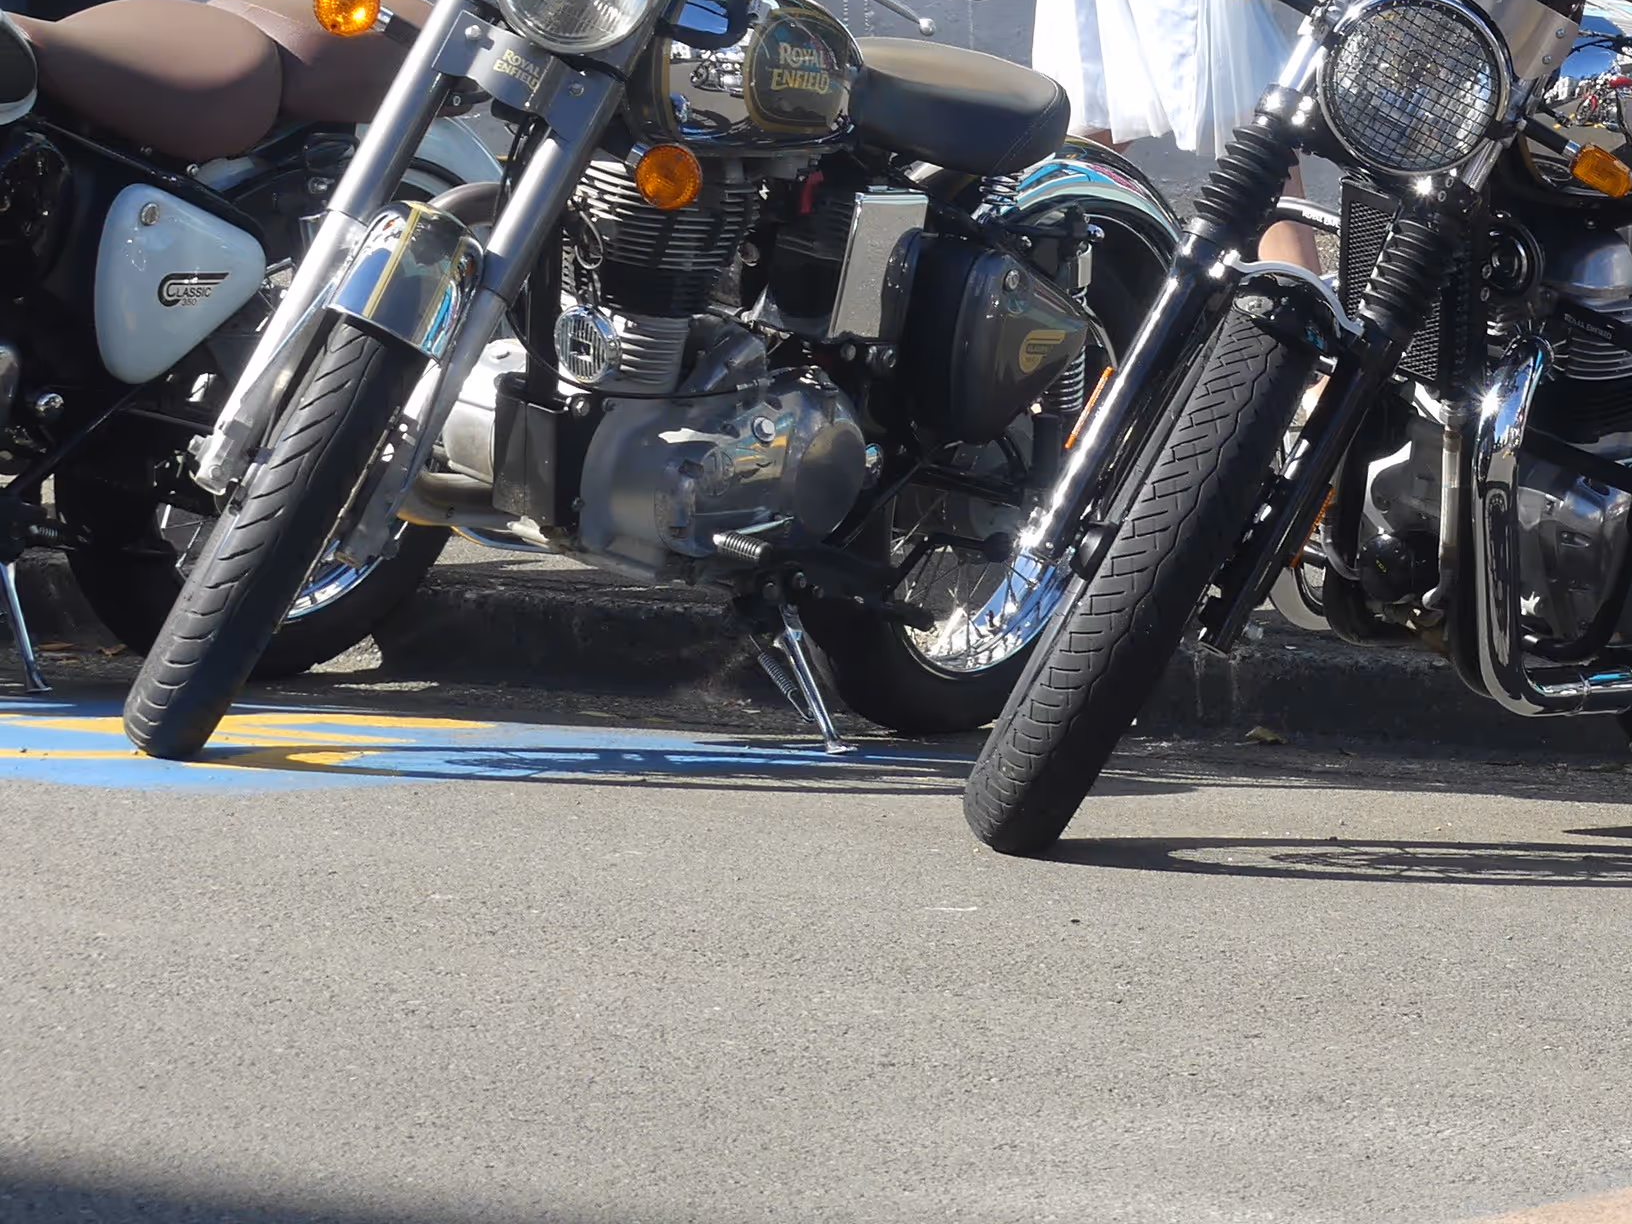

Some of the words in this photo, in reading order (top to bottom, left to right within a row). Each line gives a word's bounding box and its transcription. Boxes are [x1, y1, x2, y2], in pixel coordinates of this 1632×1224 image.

[502, 49, 540, 78] ROYAL
[779, 42, 827, 69] ROYAL
[770, 68, 830, 94] ENFIELD
